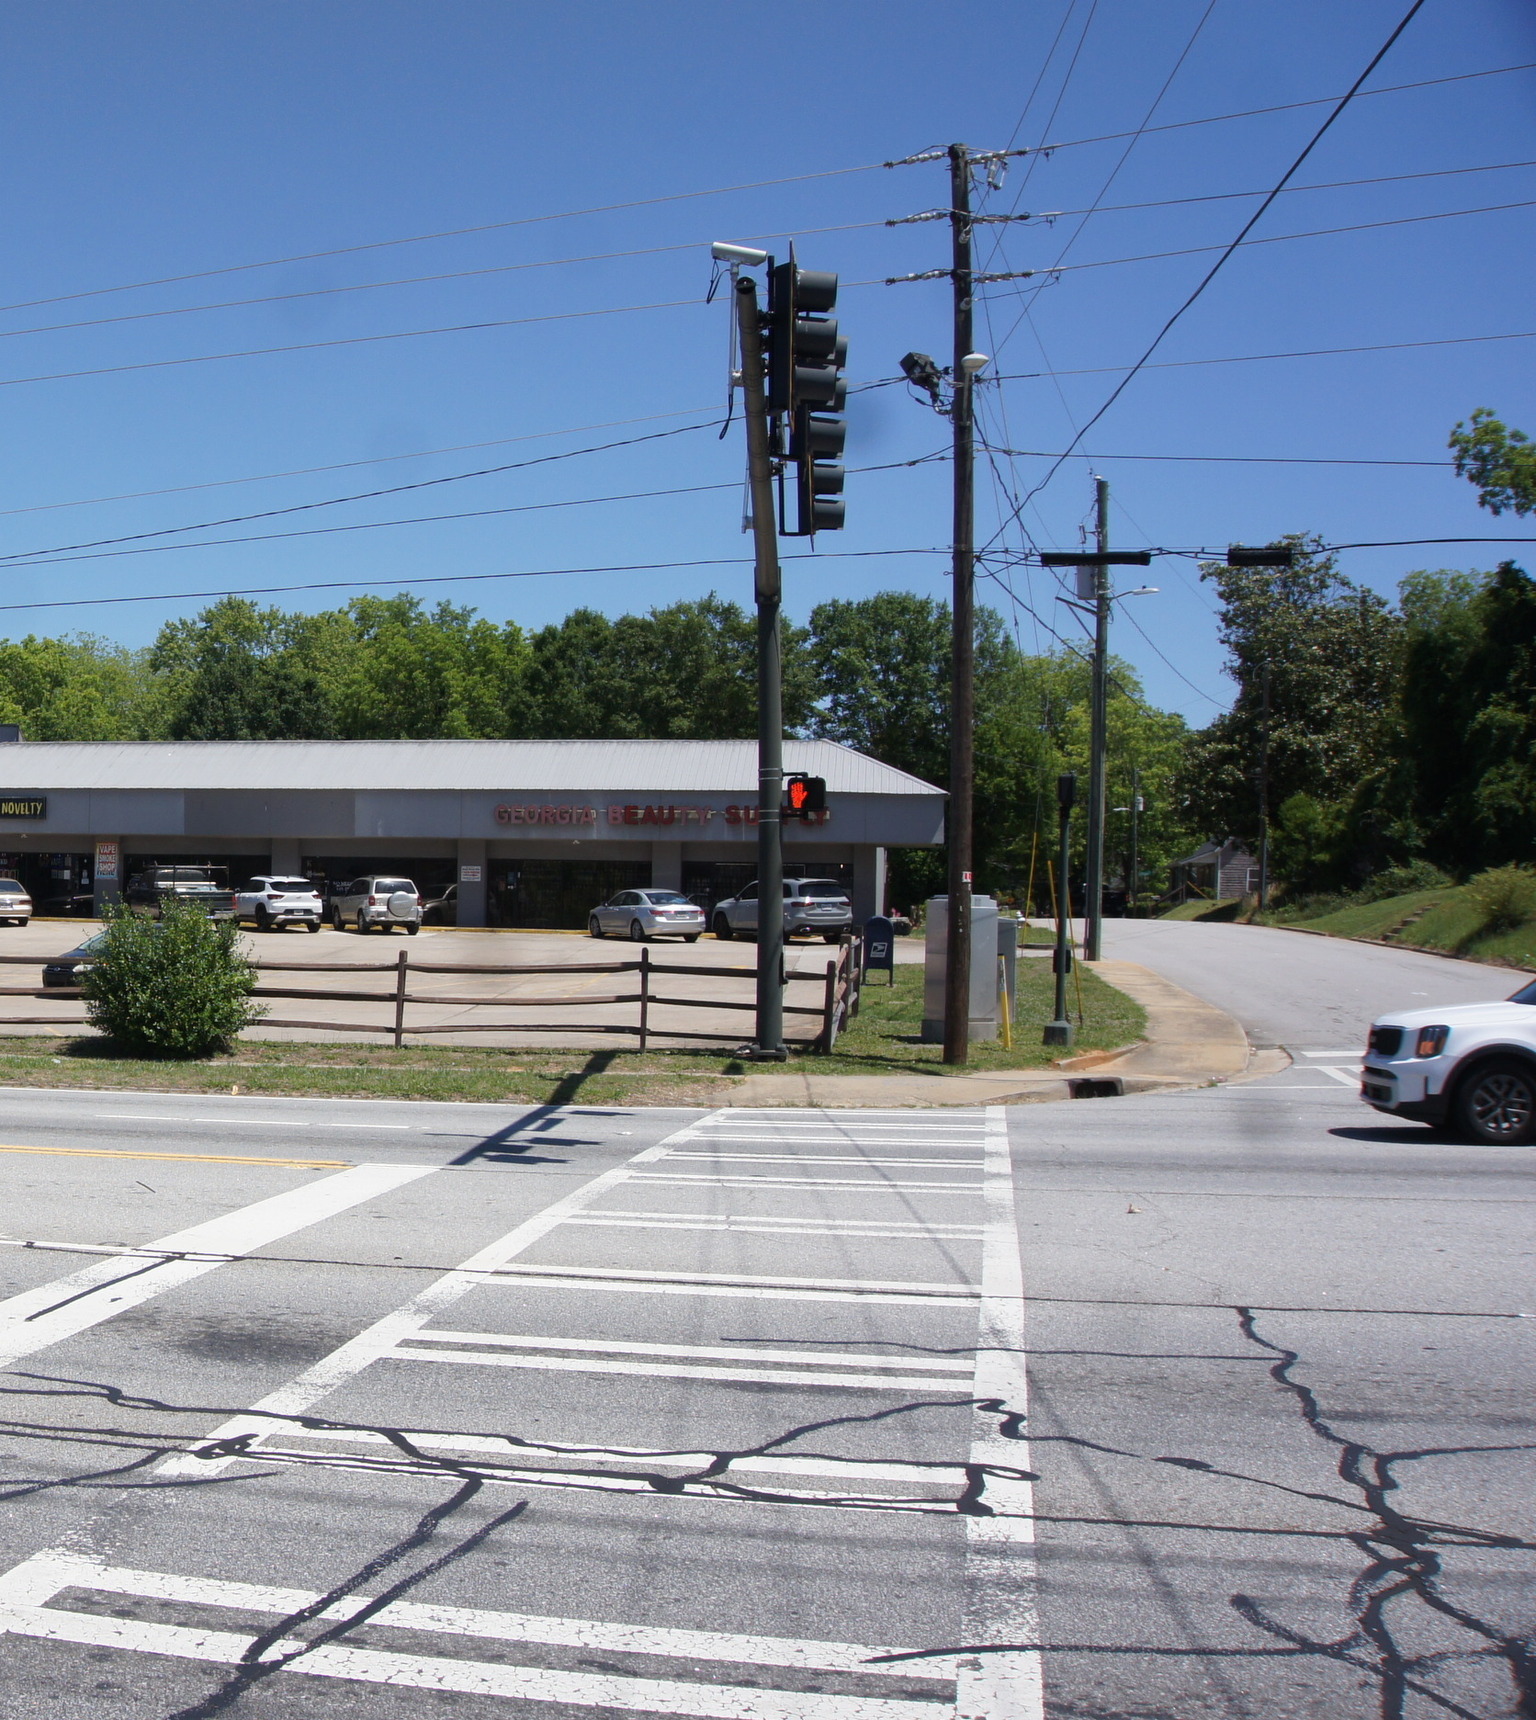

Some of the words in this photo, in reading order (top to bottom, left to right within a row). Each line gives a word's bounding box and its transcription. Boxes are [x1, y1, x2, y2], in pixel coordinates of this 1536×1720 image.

[1, 802, 43, 815] NOVELTY
[494, 804, 595, 825] GEORGIA
[606, 804, 711, 826] BEAUTY
[99, 845, 116, 853] VAPE
[99, 863, 116, 871] SHOP
